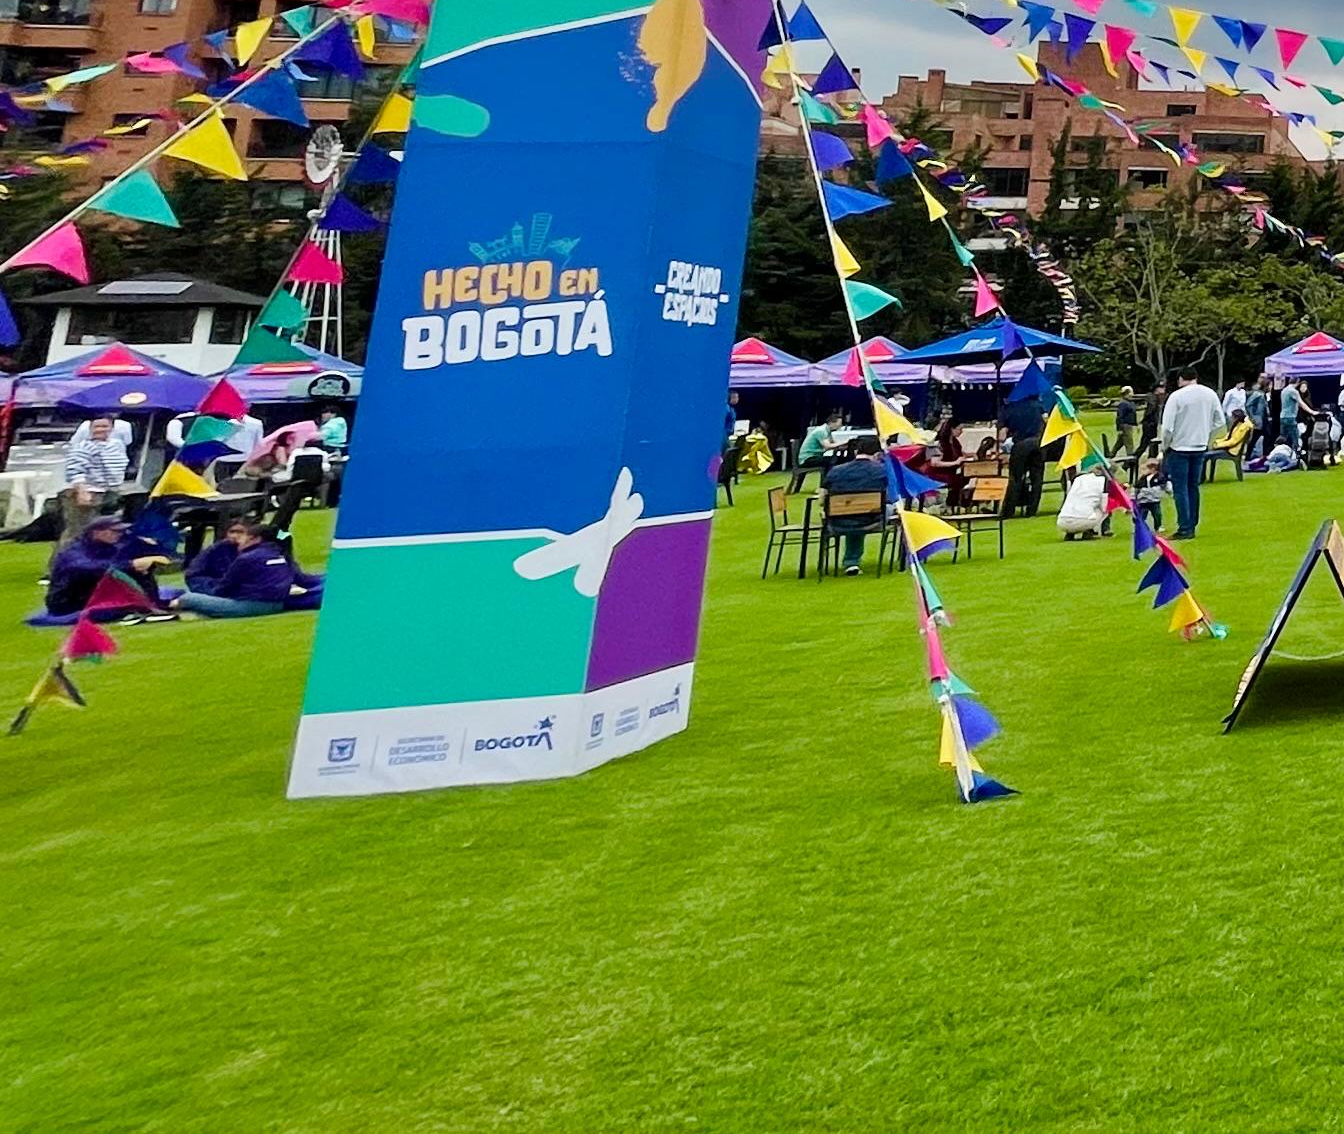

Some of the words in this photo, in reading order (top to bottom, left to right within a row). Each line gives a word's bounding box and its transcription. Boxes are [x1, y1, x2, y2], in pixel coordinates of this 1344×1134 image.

[423, 260, 553, 311] HECHO
[559, 267, 599, 296] EN
[402, 289, 613, 370] BOGOTÁ
